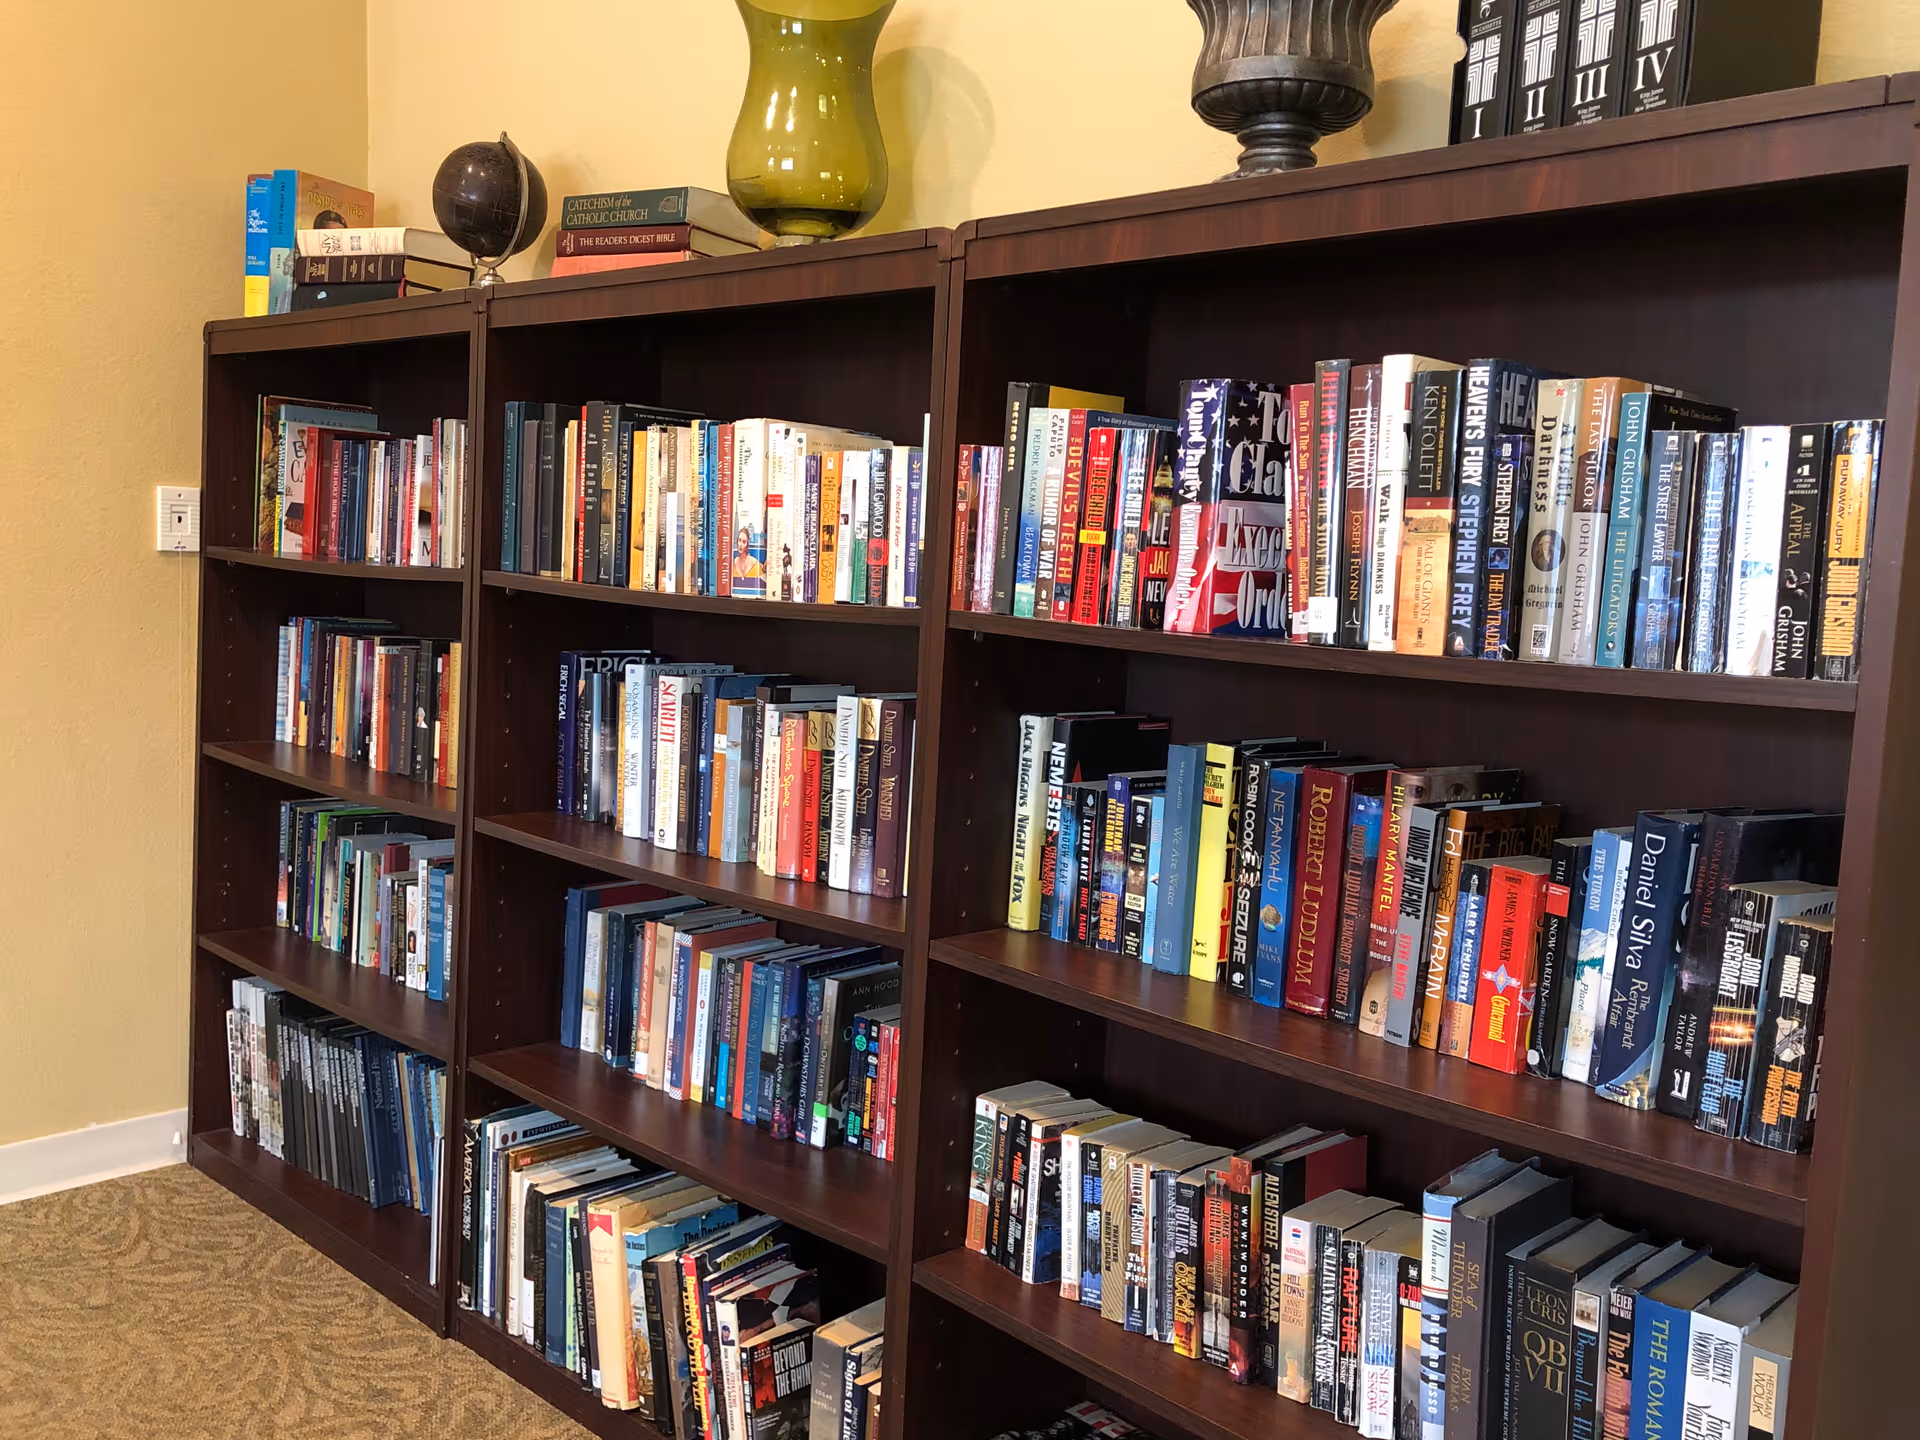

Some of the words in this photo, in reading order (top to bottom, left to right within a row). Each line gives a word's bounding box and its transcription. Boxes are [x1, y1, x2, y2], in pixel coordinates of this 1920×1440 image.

[1572, 64, 1610, 107] III
[1633, 46, 1675, 91] IV
[1472, 107, 1484, 139] I
[1524, 86, 1548, 122] II
[308, 192, 335, 209] DESIRE
[567, 212, 608, 225] CATHOLIC
[610, 208, 648, 222] CHURCH
[568, 198, 615, 211] CATECHISM
[615, 198, 621, 207] of
[622, 197, 631, 207] the
[579, 238, 593, 246] THE
[595, 236, 628, 245] READER'S
[629, 234, 654, 244] DIGEST
[656, 233, 675, 242] BIBLE
[1010, 401, 1019, 442] METRO
[1424, 385, 1440, 419] KEN
[1465, 366, 1490, 440] HEAVEN'S
[1627, 401, 1641, 442] JOHN
[1031, 429, 1041, 466] FREDRIK
[1049, 414, 1058, 458] CAPUTO
[1347, 407, 1368, 489] HENCHMAN
[1007, 444, 1015, 472] GIRL
[1418, 424, 1437, 492] FOLLETT
[1461, 445, 1485, 487] FURY
[874, 468, 886, 491] JULIE
[1028, 469, 1038, 516] BACKMAN
[1063, 446, 1082, 513] DEVIL'S
[1495, 463, 1513, 515] STEPHEN
[1618, 449, 1637, 520] GRISHAM
[1837, 459, 1849, 520] RUNAWAY
[873, 492, 885, 538] GARWOOD
[1379, 483, 1391, 524] Walk
[1057, 520, 1076, 578] TEETH
[1350, 509, 1363, 554] JOSEPH
[1379, 526, 1387, 548] through
[1455, 494, 1480, 574] STEPHEN
[1492, 513, 1510, 545] FREY
[1576, 517, 1591, 558] JOHN
[1616, 529, 1628, 555] THE
[1786, 502, 1806, 558] APPEAL
[1803, 522, 1812, 539] THE
[1834, 520, 1845, 554] JURY
[908, 542, 916, 573] RANSOM
[1021, 526, 1034, 579] BEARTOWN
[1375, 551, 1386, 595] DARKNESS
[1349, 557, 1361, 601] FLYNN
[1571, 564, 1588, 632] GRISHAM
[1607, 558, 1625, 638] LITIGATORS
[1452, 582, 1474, 630] FREY
[1774, 605, 1793, 672] GRISHAM
[1791, 619, 1808, 659] JOHN
[560, 664, 568, 691] ERICH
[558, 692, 567, 721] SEGAL
[631, 682, 639, 740] ROSAMUNDE
[659, 680, 677, 745] SCARLETT
[756, 698, 764, 726] Burnt
[884, 709, 897, 745] DANIELLE
[754, 727, 763, 770] Mountain
[883, 745, 896, 768] STEEL
[1022, 720, 1035, 753] JACK
[630, 752, 638, 787] WINTER
[1018, 757, 1033, 808] HIGGINS
[1246, 764, 1260, 808] ROBIN
[880, 777, 898, 821] VANISHED
[1390, 785, 1405, 848] HILARY
[803, 821, 813, 860] RANSOM
[1016, 813, 1030, 861] NIGHT
[1060, 819, 1072, 859] SHADOW
[1082, 819, 1091, 851] LAURA
[1105, 798, 1116, 852] KELLERMAN
[1114, 803, 1125, 852] JONATHAN
[1242, 812, 1256, 853] COOK
[1266, 788, 1285, 892] NETANYAHU
[1305, 783, 1334, 881] ROBERT
[1444, 827, 1463, 856] Ed
[1012, 874, 1026, 904] FOX
[1059, 861, 1068, 886] PLAY
[1080, 857, 1089, 882] KAYE
[1379, 849, 1398, 913] MANTEL
[1556, 859, 1566, 883] THE
[1613, 869, 1623, 907] BROKEN
[1635, 831, 1666, 909] Daniel
[1080, 888, 1089, 911] RIDE
[1466, 895, 1478, 935] LARRY
[1078, 913, 1087, 941] HARD
[1233, 887, 1251, 965] SEIZURE
[1295, 884, 1324, 986] LUDLUM
[1370, 922, 1388, 933] BRING
[1375, 938, 1388, 947] THE
[1545, 916, 1558, 953] SNOW
[1607, 909, 1618, 939] CIRCLE
[1625, 915, 1655, 970] Silva
[1256, 950, 1281, 963] EVANS
[1258, 943, 1280, 954] MIKE
[1369, 950, 1392, 962] BODIES
[1426, 913, 1449, 999] McBAIN
[1718, 930, 1745, 999] LESCROART
[1739, 950, 1762, 988] JOHN
[1458, 937, 1475, 1002] McMURTRY
[1541, 954, 1555, 1003] GARDEN
[1779, 954, 1801, 999] MORRELL
[1798, 972, 1816, 1005] DAVID
[1488, 994, 1510, 1043] Centennial
[1608, 988, 1628, 1029] Affair
[1622, 978, 1649, 1050] Rembrandt
[1639, 997, 1651, 1011] The
[1673, 1013, 1687, 1051] TAYLOR
[1682, 1013, 1698, 1059] ANDREW
[1722, 1078, 1744, 1101] THE
[463, 1136, 475, 1195] AMERICA
[973, 1119, 988, 1172] KING
[1175, 1205, 1189, 1255] ROLLINS
[1189, 1218, 1197, 1248] JAMES
[1126, 1263, 1146, 1273] Pied
[1129, 1253, 1145, 1263] The
[1431, 1228, 1448, 1283] Mohawk
[1124, 1272, 1147, 1283] Piper
[1260, 1252, 1271, 1330] DESCENT
[1269, 1263, 1281, 1325] LUNAR
[1283, 1283, 1305, 1298] TOWNS
[1287, 1274, 1301, 1286] HILL
[1451, 1241, 1466, 1319] THUNDER
[584, 1270, 596, 1327] DENVER
[1341, 1267, 1359, 1354] RAPTURE
[1369, 1289, 1381, 1344] THAYER
[1381, 1292, 1392, 1337] STEVE
[1525, 1284, 1569, 1313] LEON
[1529, 1300, 1567, 1326] URIS
[1610, 1292, 1633, 1310] MEIER
[774, 1341, 805, 1374] BEYOND
[1523, 1329, 1568, 1367] QB
[1573, 1331, 1597, 1386] Beyond
[1649, 1319, 1671, 1364] THE
[776, 1375, 791, 1398] THE
[845, 1360, 856, 1399] Signs
[1368, 1371, 1378, 1414] SNOW
[1451, 1354, 1461, 1413] THOMAS
[1461, 1366, 1472, 1404] EVAN
[1523, 1355, 1565, 1396] VII
[1752, 1371, 1766, 1417] WOUK
[844, 1401, 853, 1414] of
[1573, 1387, 1593, 1411] the
[1765, 1374, 1775, 1420] HERMAN
